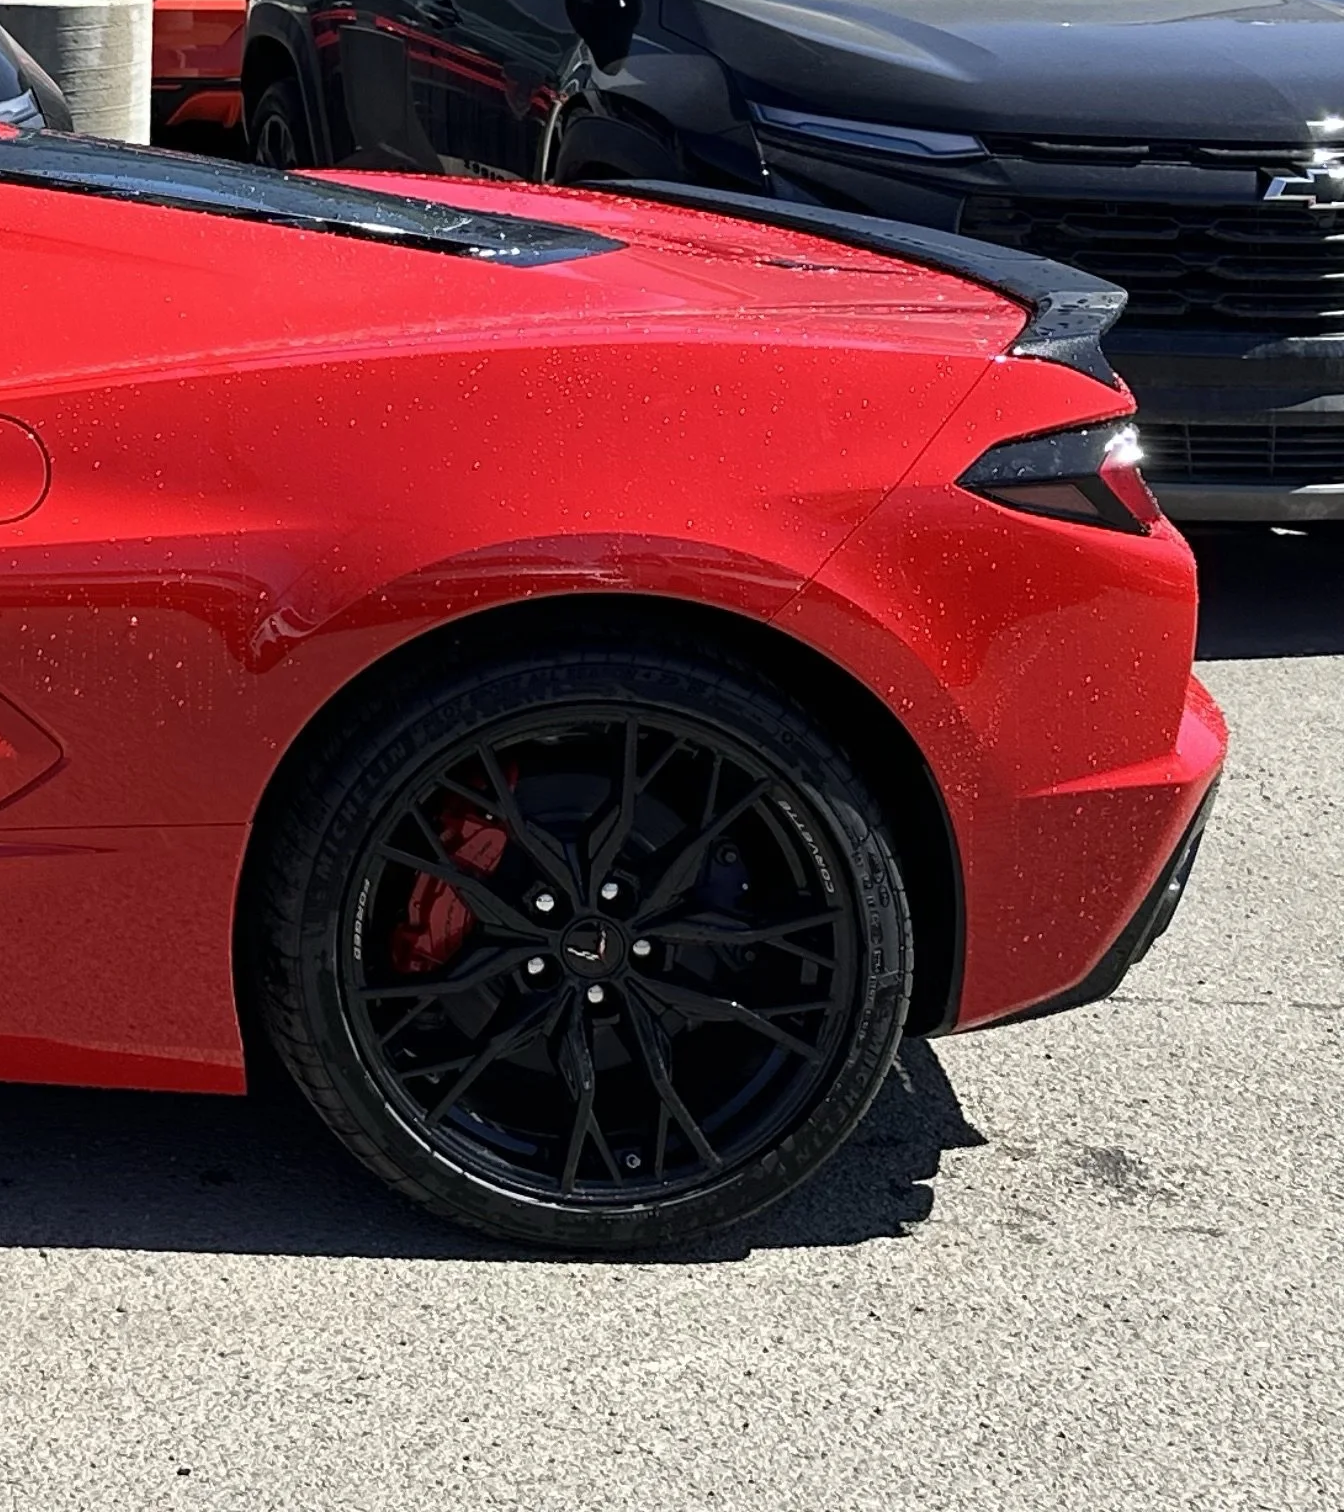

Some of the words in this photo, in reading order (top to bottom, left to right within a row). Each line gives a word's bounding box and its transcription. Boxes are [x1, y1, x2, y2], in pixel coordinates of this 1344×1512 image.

[315, 740, 407, 881] MICHELIN
[777, 799, 835, 894] CORVETTE
[353, 877, 372, 961] FORGED
